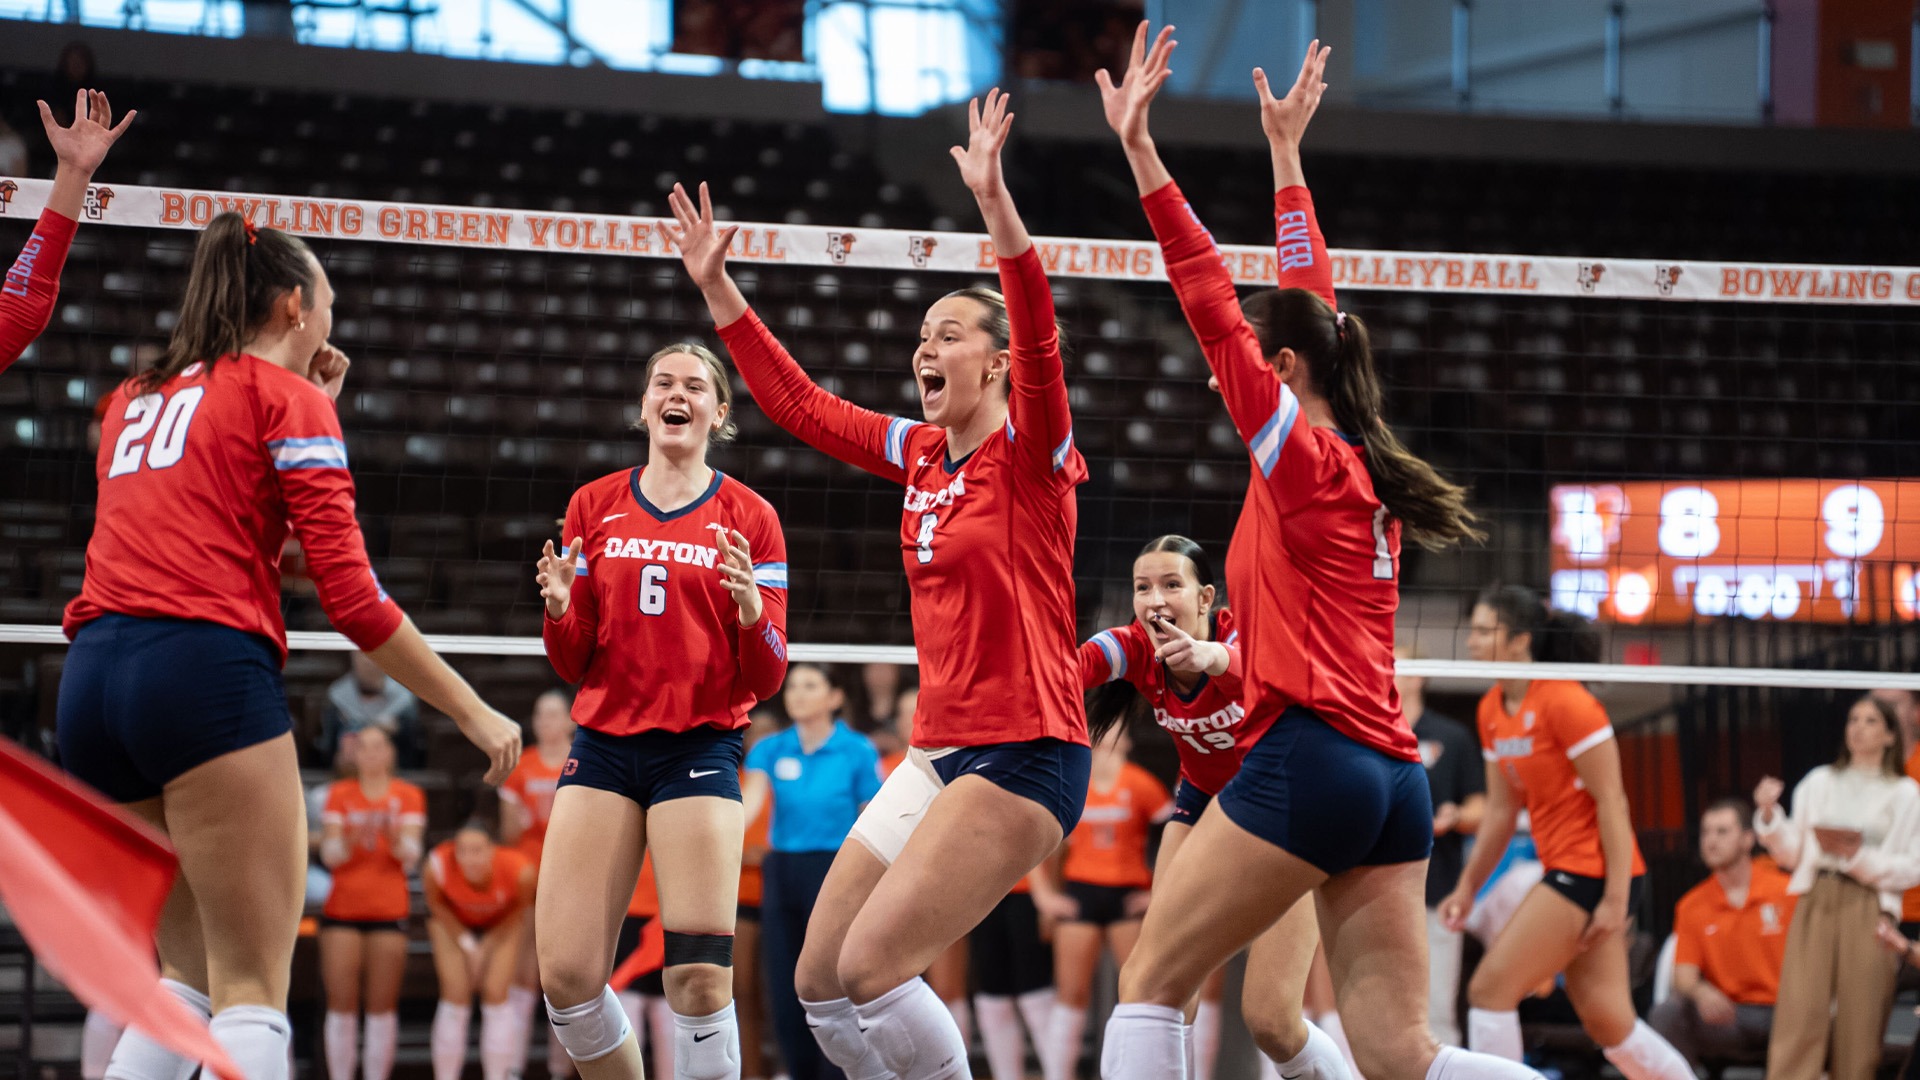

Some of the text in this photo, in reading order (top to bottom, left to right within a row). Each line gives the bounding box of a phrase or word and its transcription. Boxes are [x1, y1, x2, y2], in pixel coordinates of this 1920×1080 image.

[160, 190, 364, 237] BOWLING
[376, 207, 514, 245] GREEN
[1279, 210, 1314, 272] FLYER
[977, 239, 1153, 277] BWLING
[1330, 255, 1539, 290] OLLEYBALL
[1720, 267, 1893, 299] BOWLING
[108, 385, 206, 480] 20
[1658, 486, 1720, 558] 8
[1822, 484, 1885, 558] 9
[603, 537, 719, 569] DAYTON
[638, 563, 668, 616] 6
[1153, 701, 1246, 734] DAYTON
[1181, 731, 1236, 755] 19
